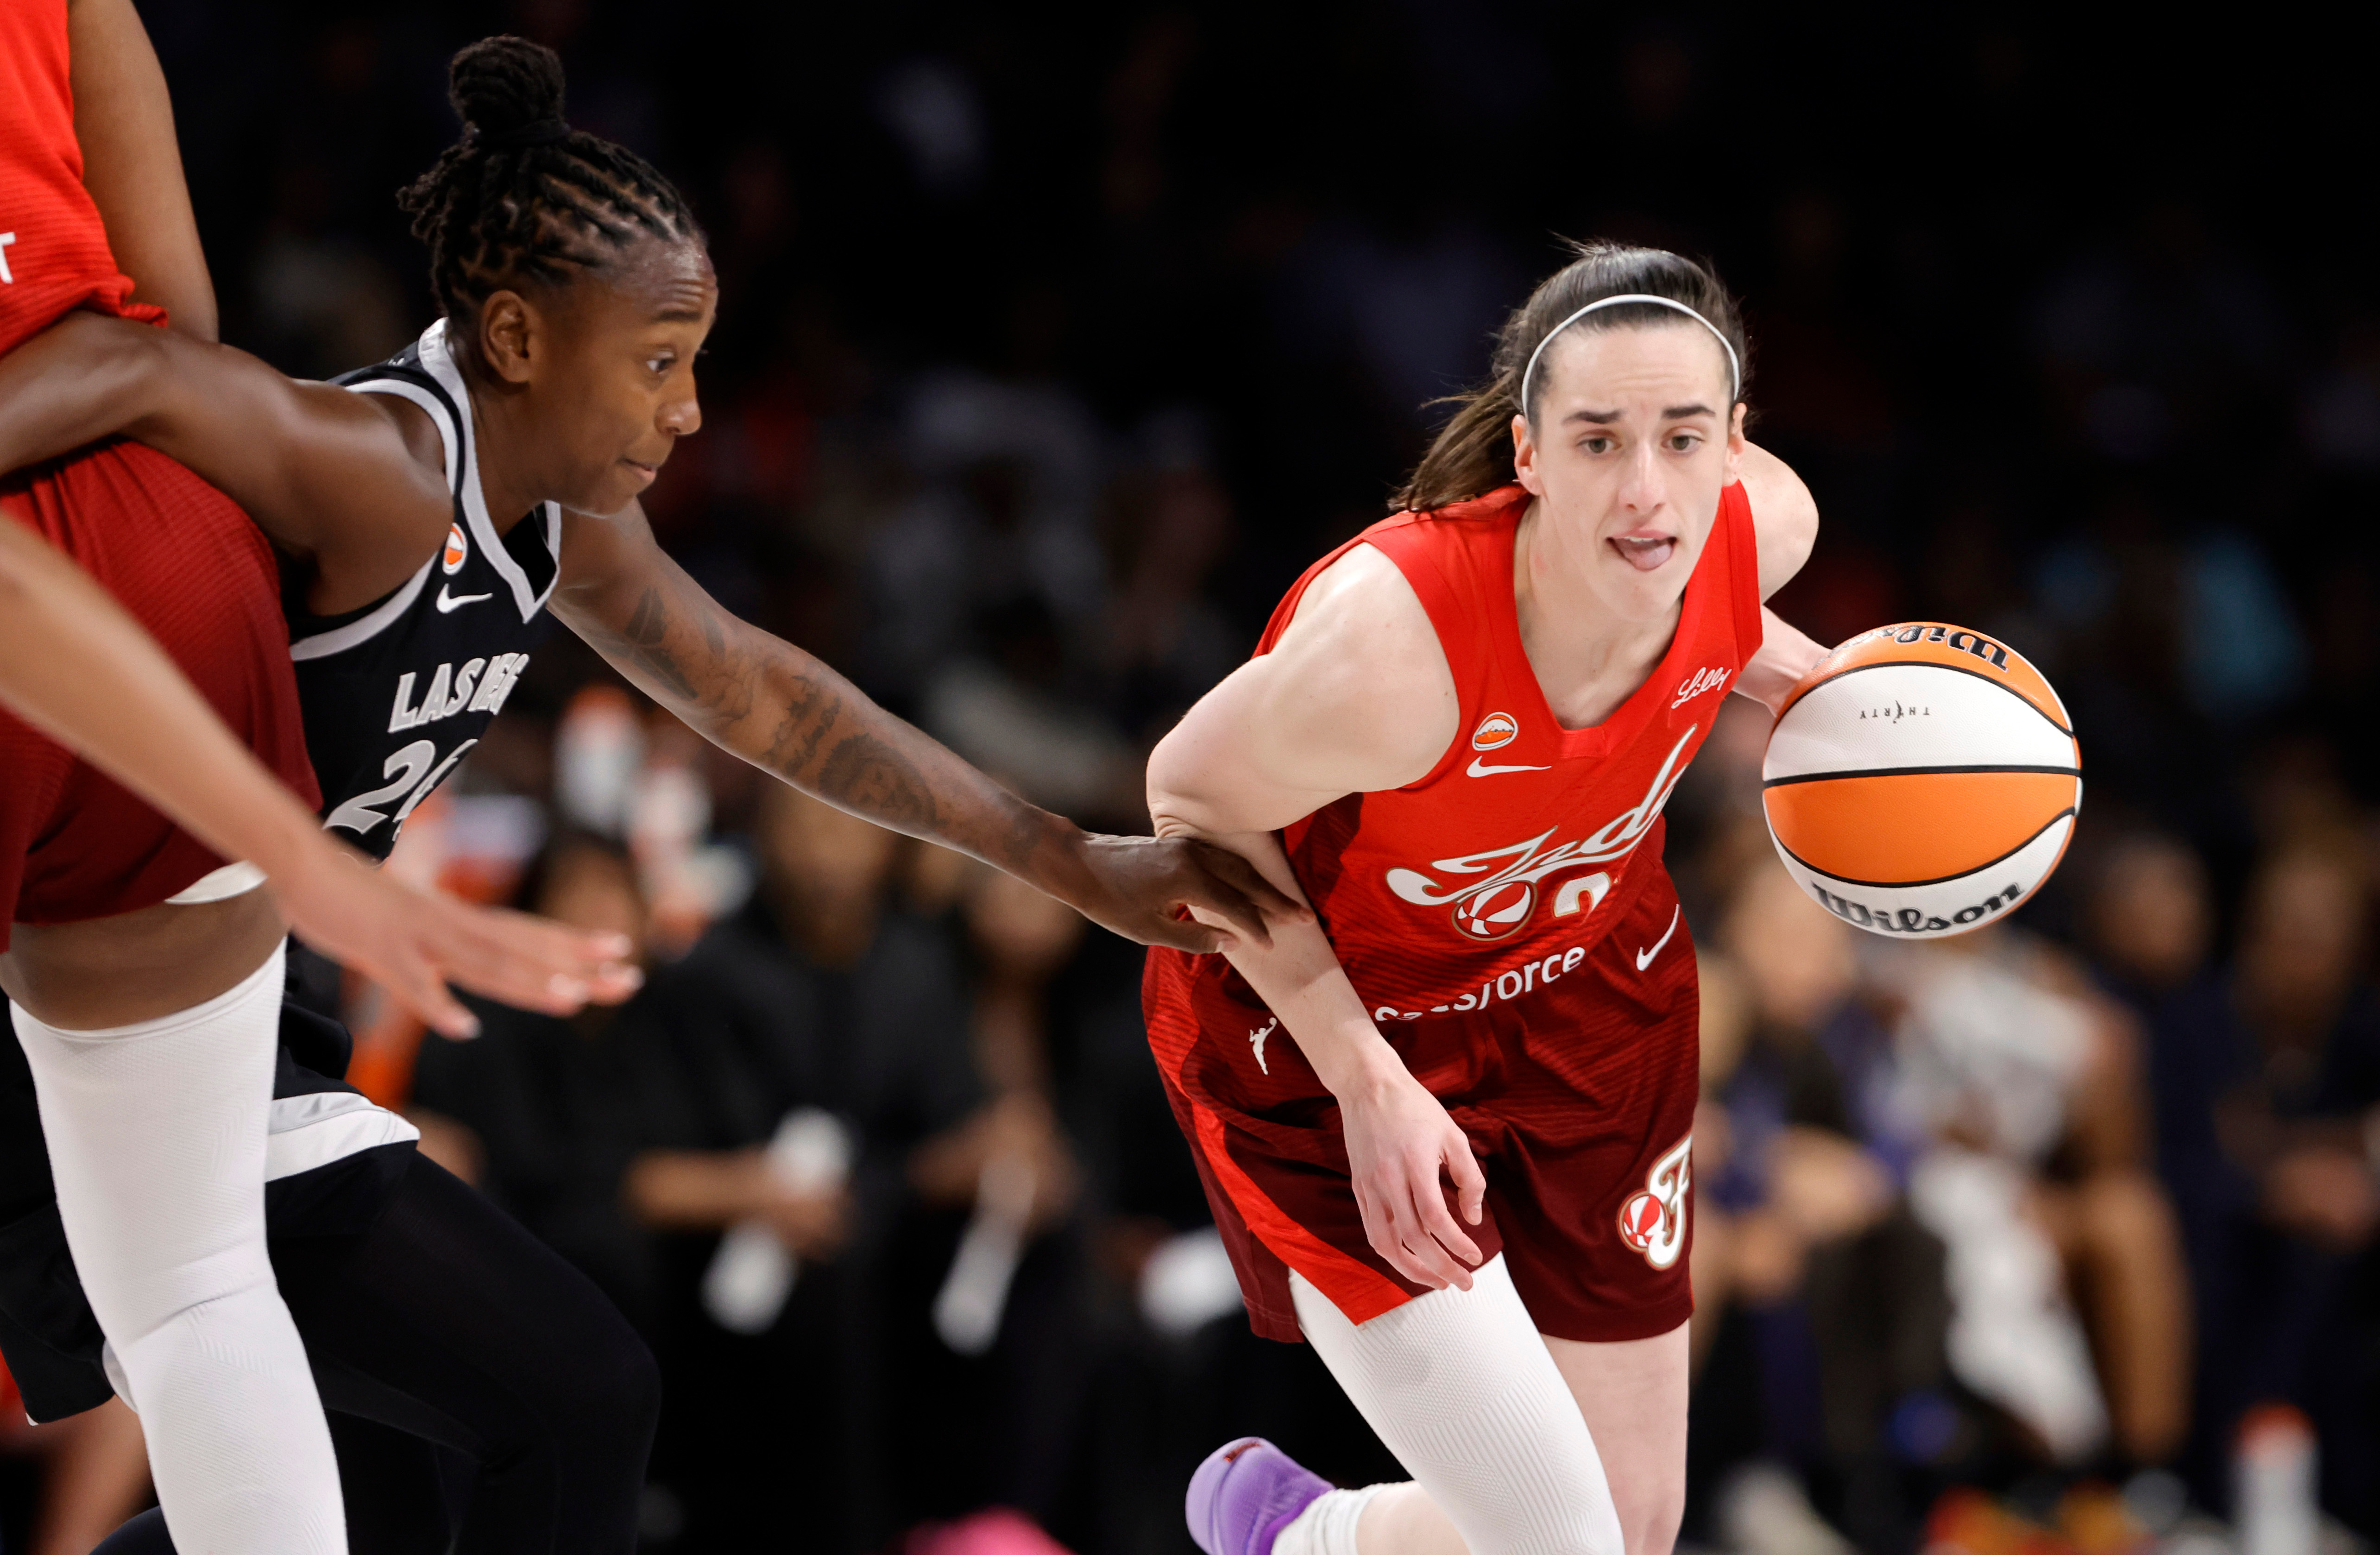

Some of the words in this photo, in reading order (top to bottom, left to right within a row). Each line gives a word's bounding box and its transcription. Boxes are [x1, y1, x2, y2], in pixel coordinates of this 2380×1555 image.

[388, 657, 486, 733] LAS
[1671, 667, 1732, 709] Lilly
[1811, 881, 2023, 932] Wilson
